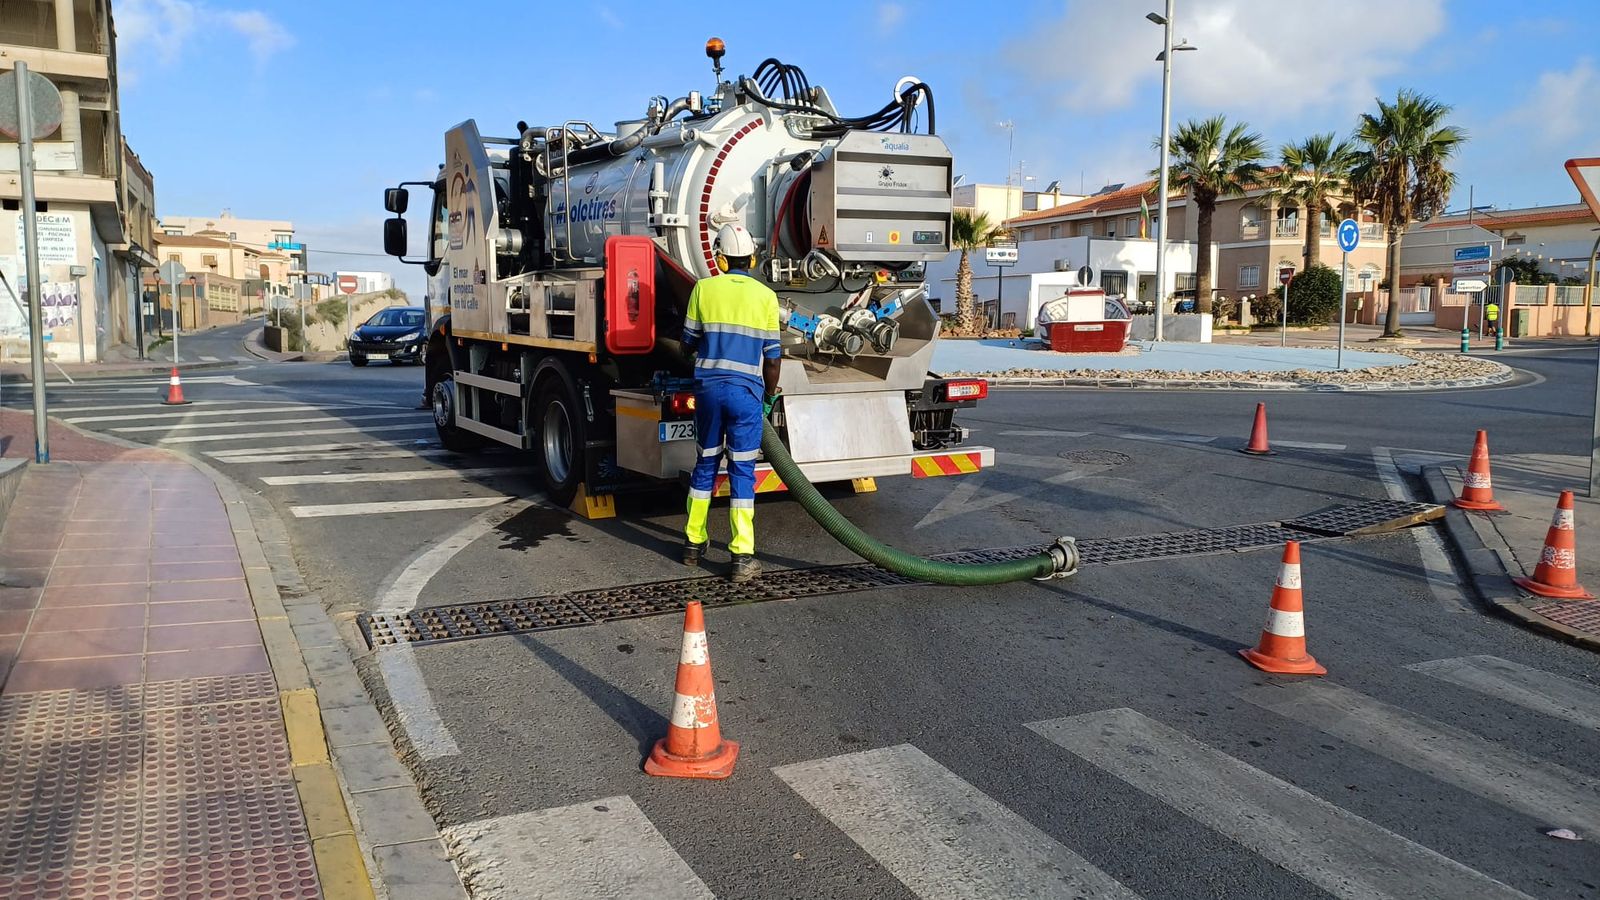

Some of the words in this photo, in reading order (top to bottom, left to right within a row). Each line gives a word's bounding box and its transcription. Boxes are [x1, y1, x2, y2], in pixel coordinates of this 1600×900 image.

[884, 142, 909, 151] aqualia
[878, 180, 892, 188] Grupo
[556, 196, 617, 224] #olotires
[453, 267, 458, 278] El
[459, 269, 468, 279] mar
[454, 283, 474, 296] empieza
[454, 299, 460, 309] en
[467, 297, 479, 310] calle
[671, 423, 695, 439] 723
